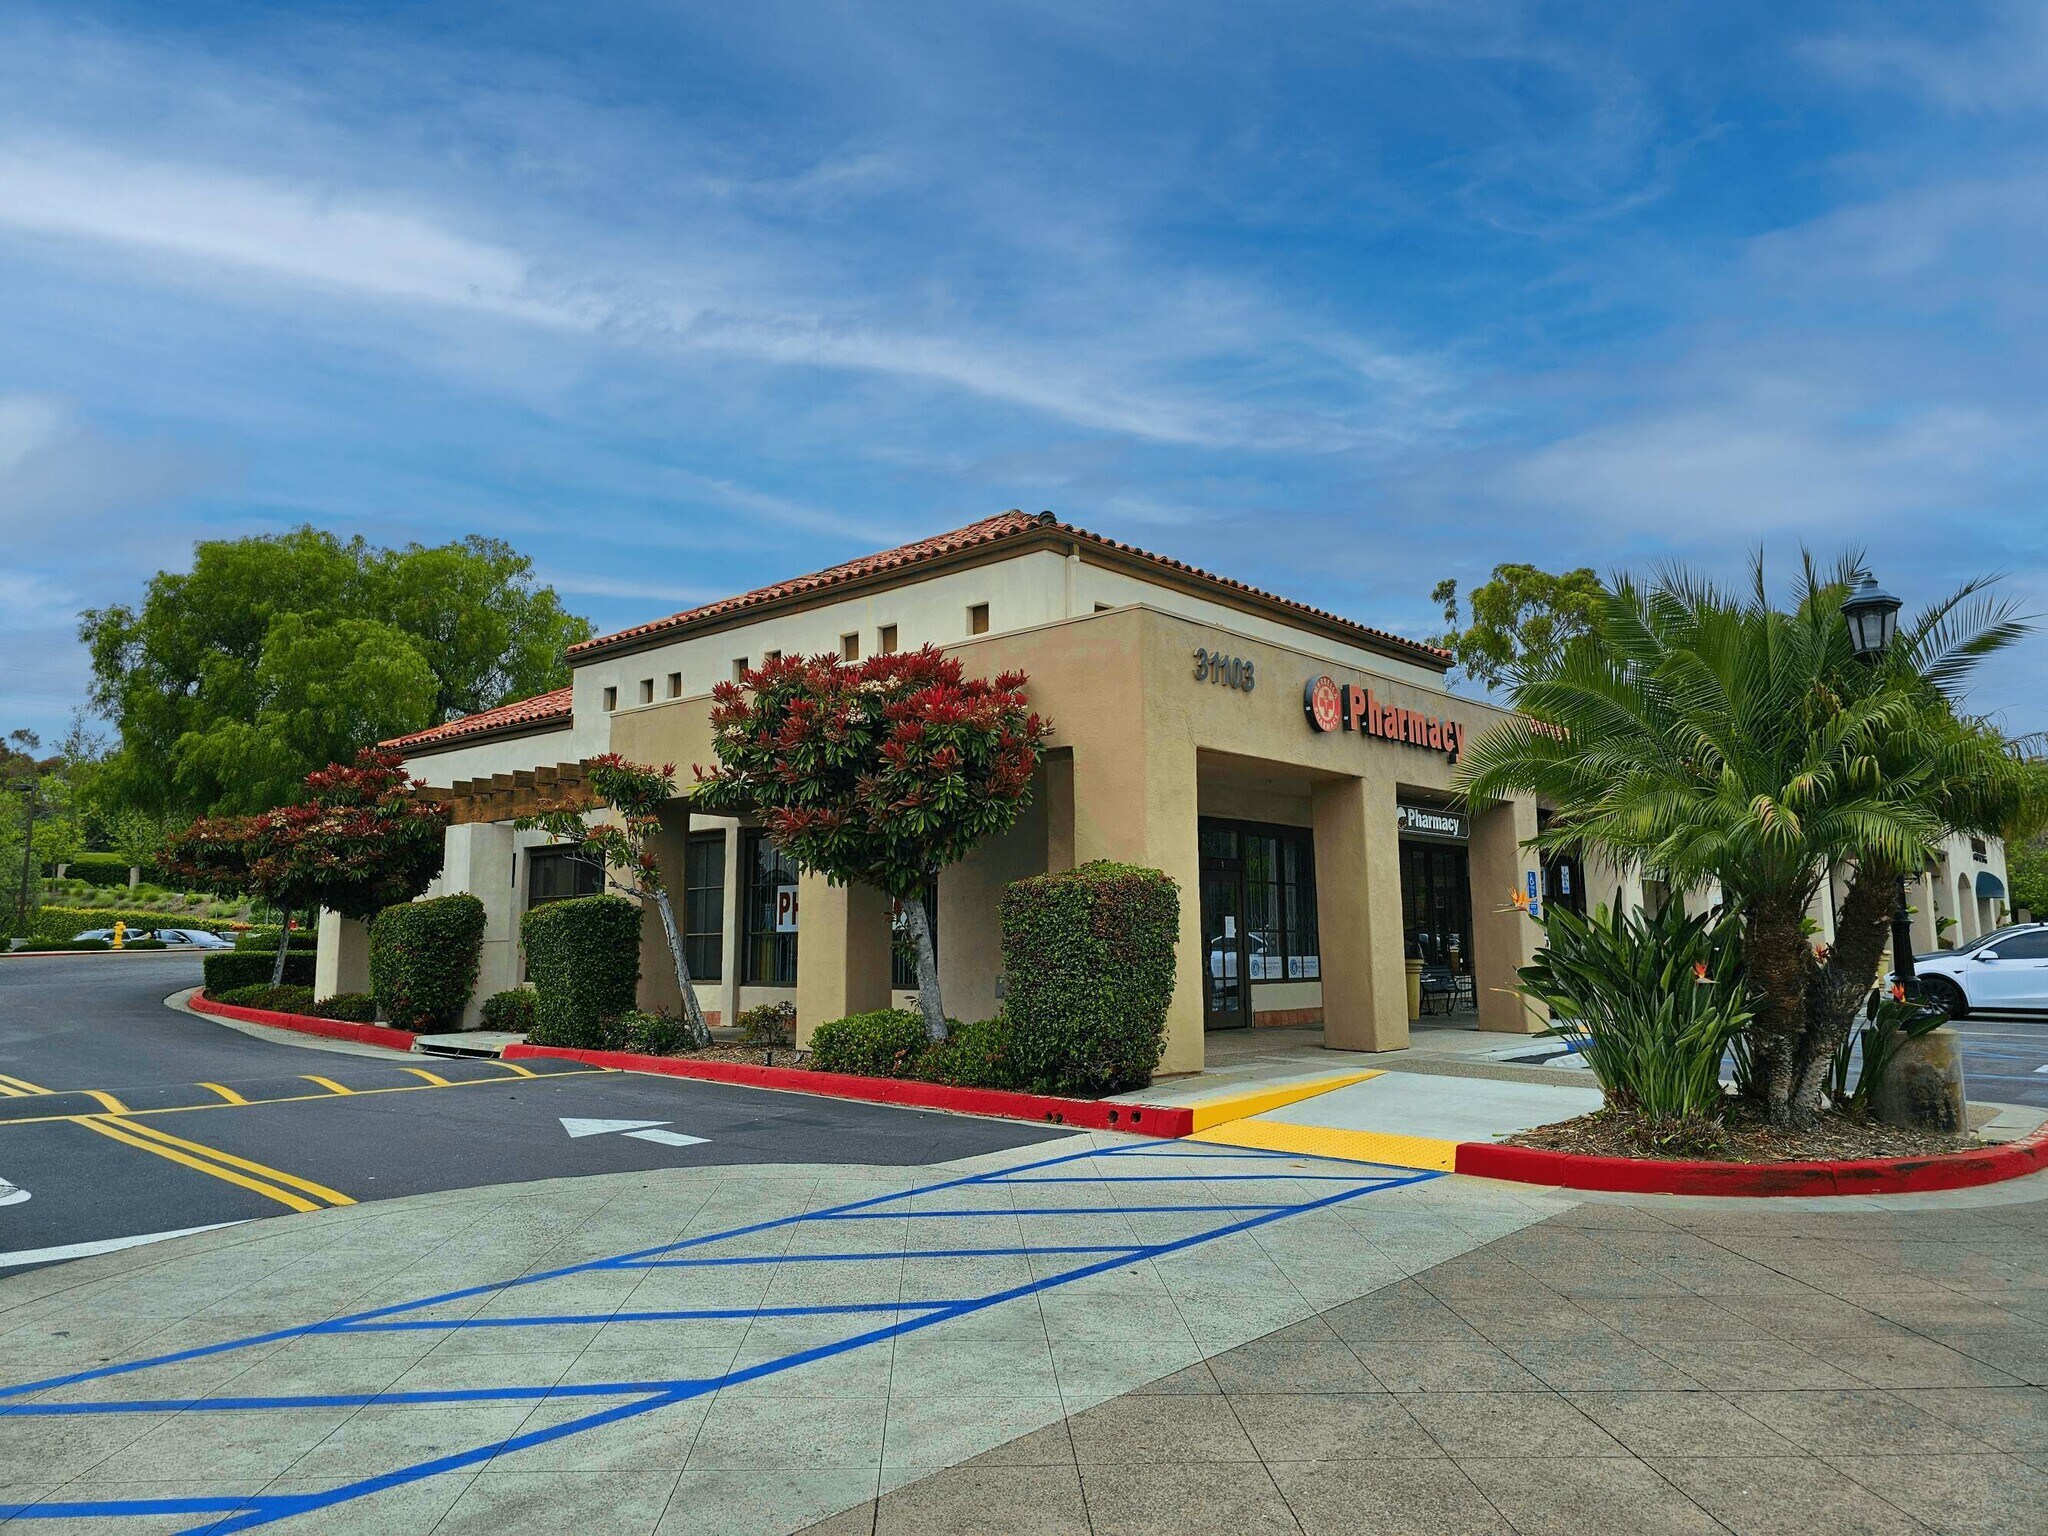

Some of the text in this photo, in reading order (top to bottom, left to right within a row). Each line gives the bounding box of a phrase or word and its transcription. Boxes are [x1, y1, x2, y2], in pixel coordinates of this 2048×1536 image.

[1193, 648, 1255, 692] 31103
[1347, 684, 1465, 764] Pharmacy
[1407, 808, 1459, 836] Pharmacy
